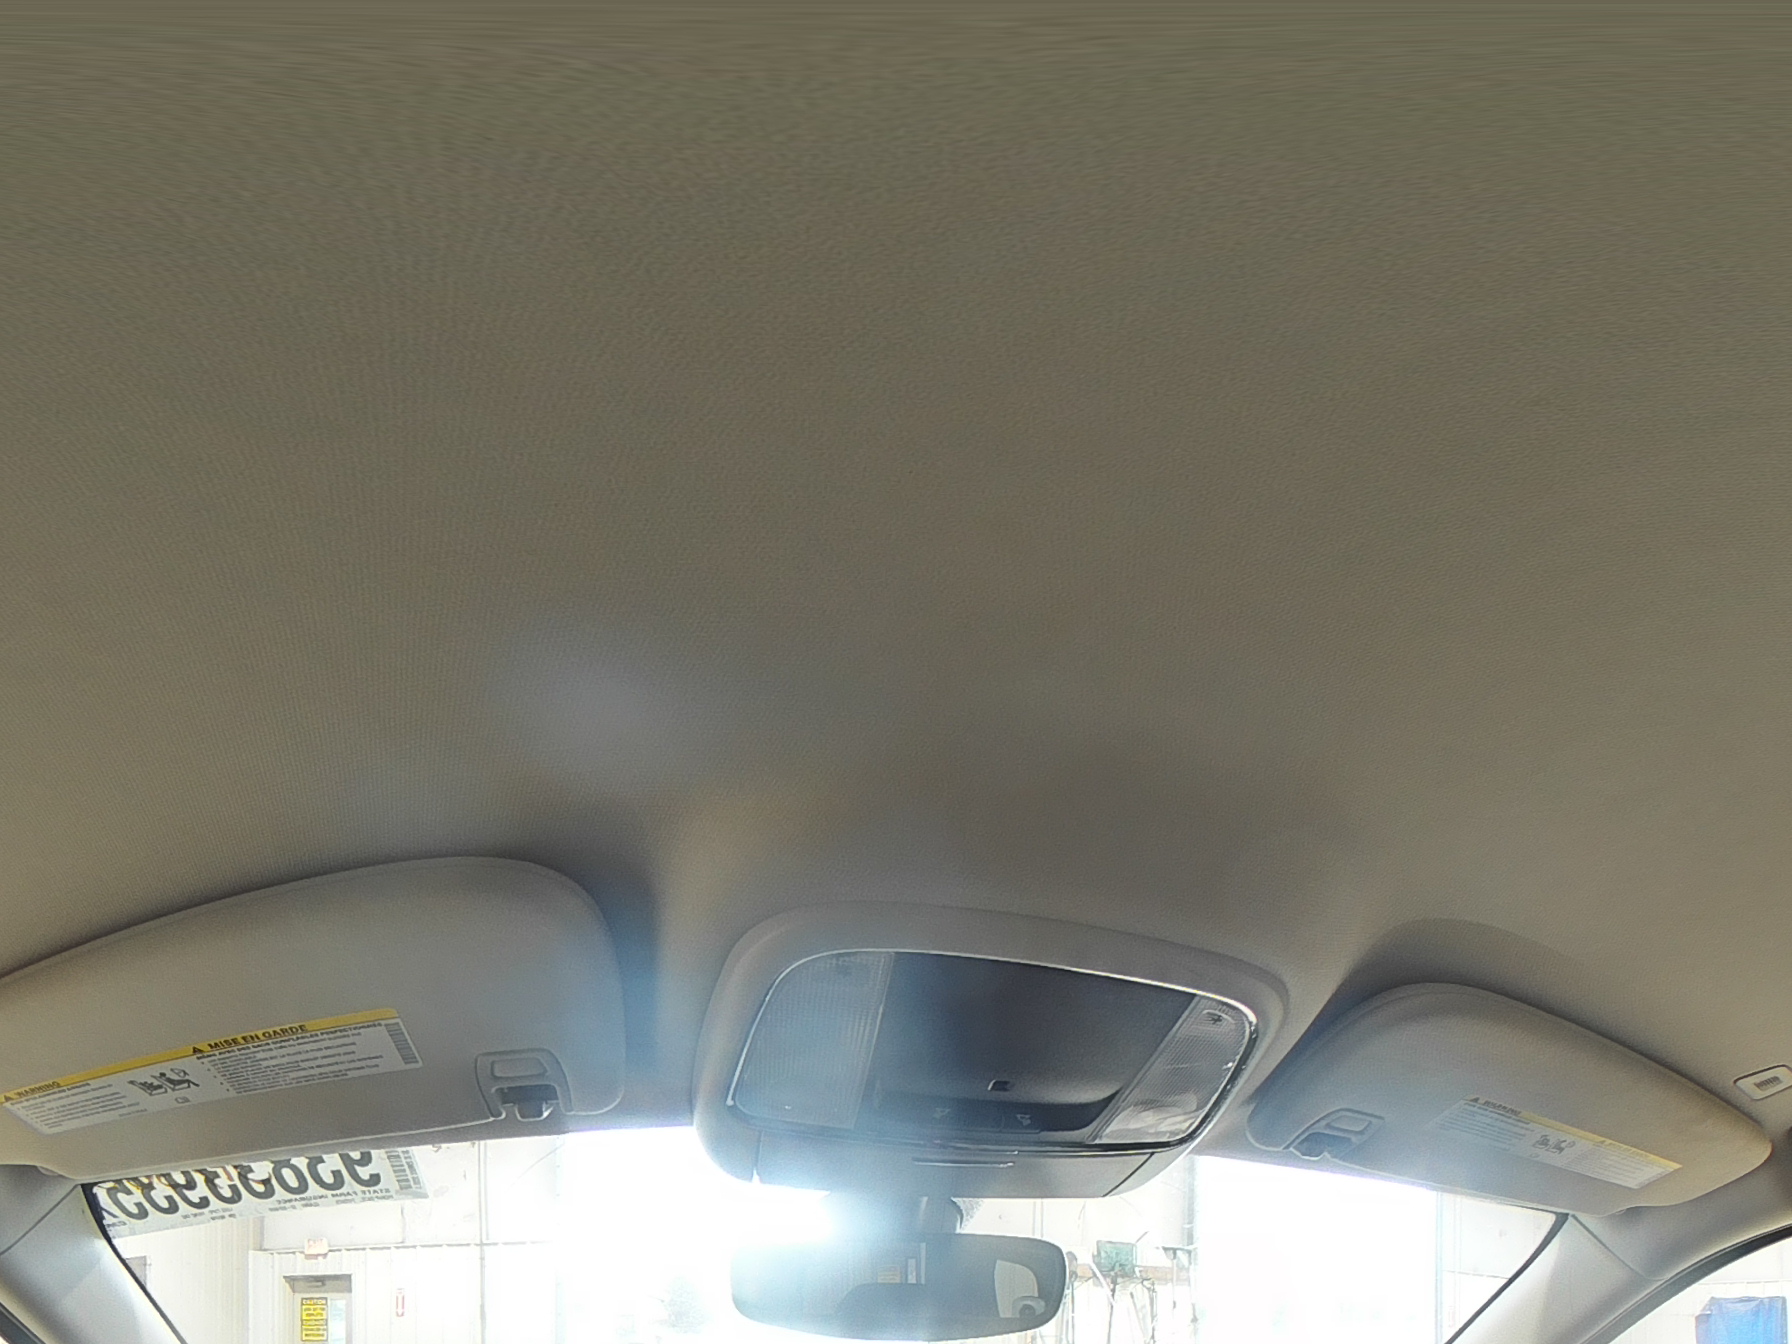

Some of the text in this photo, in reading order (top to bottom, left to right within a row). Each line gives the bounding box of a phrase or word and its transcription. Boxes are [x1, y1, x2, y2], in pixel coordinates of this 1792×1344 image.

[207, 1024, 308, 1051] MISE EN GARDE
